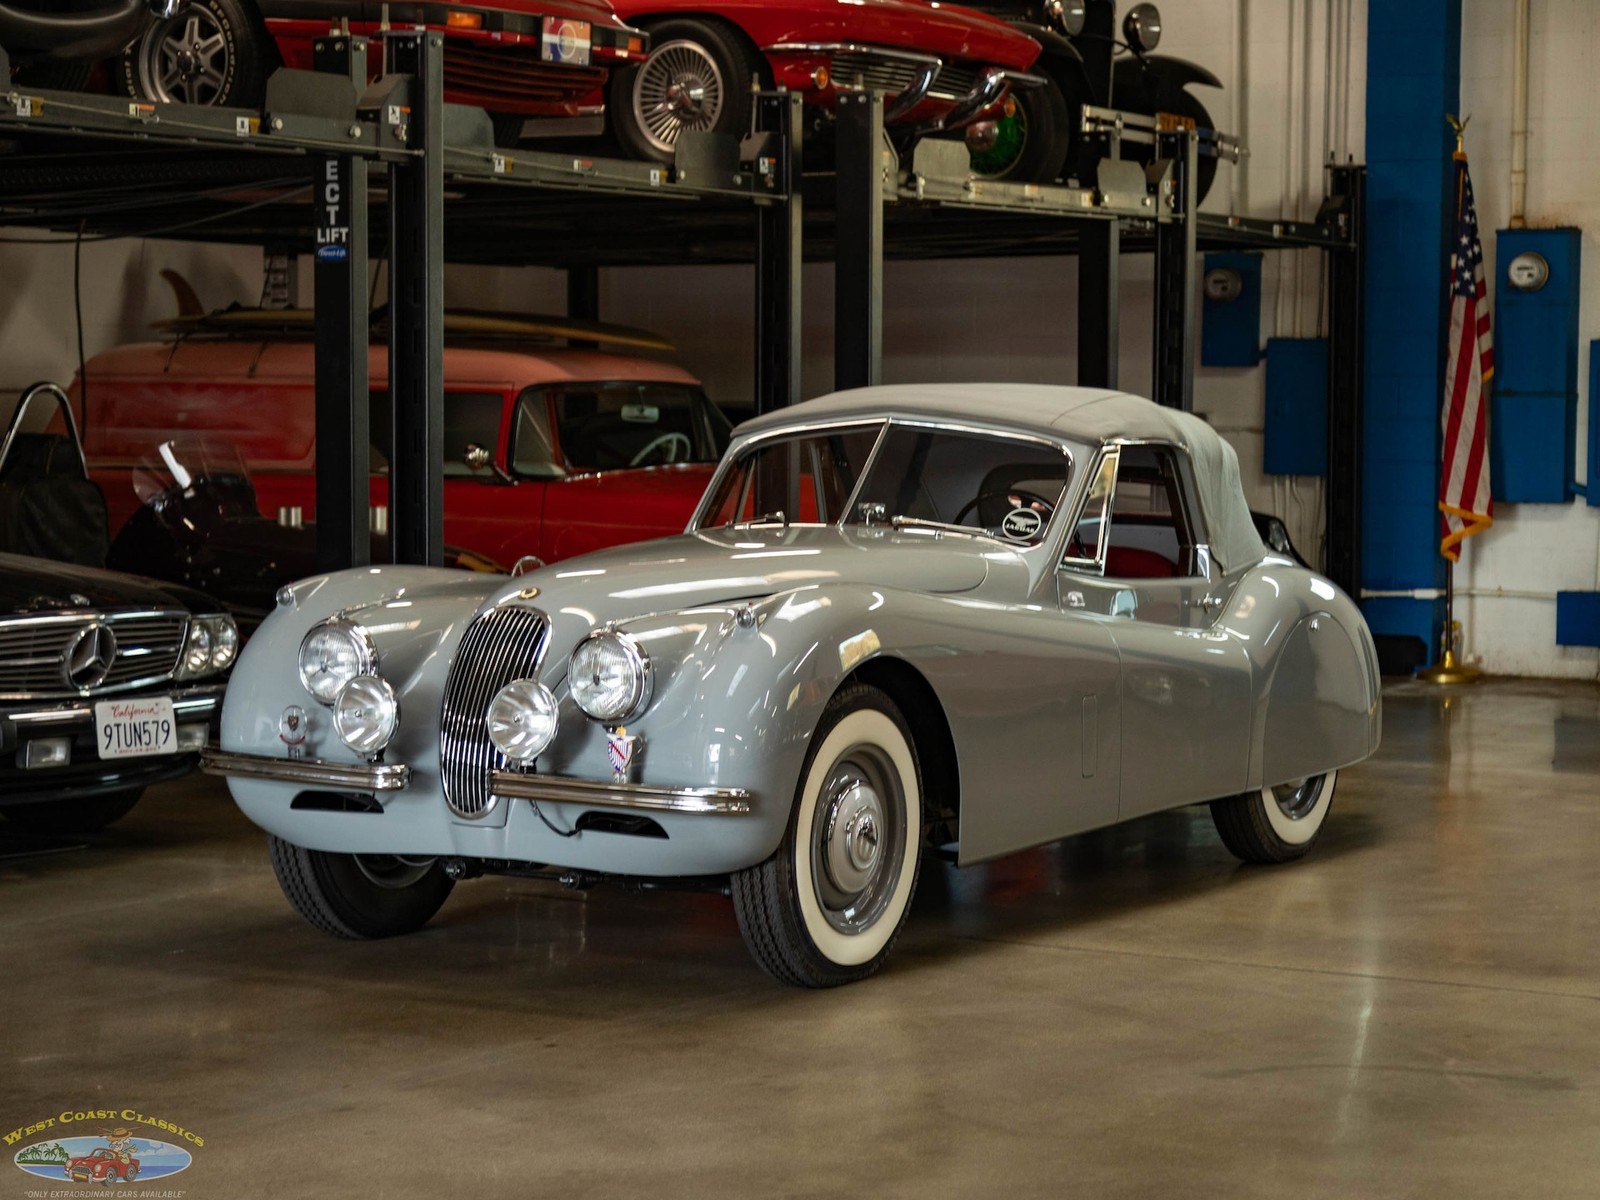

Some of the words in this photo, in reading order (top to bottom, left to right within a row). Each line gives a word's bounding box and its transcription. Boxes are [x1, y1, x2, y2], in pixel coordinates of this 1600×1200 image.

[317, 227, 349, 243] LIFT
[1006, 523, 1034, 533] JAGUAR
[113, 703, 155, 719] California
[104, 719, 170, 750] 9TUN579
